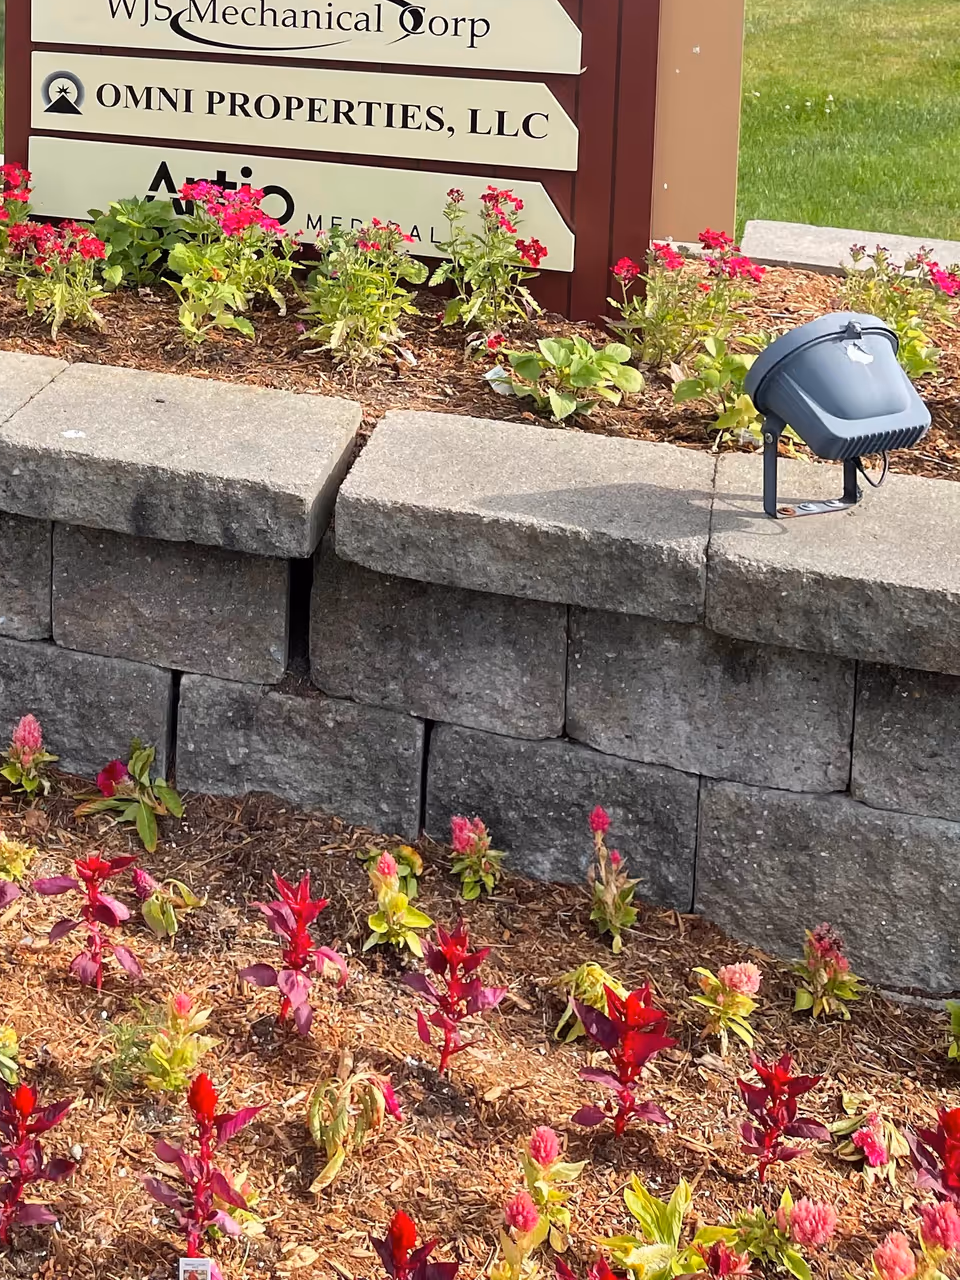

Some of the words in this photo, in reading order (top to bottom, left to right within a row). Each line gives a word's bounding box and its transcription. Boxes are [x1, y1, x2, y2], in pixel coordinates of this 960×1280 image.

[398, 5, 491, 48] Corp
[97, 84, 193, 113] OMNI
[205, 91, 454, 138] PROPERTIES,
[468, 109, 549, 139] LLC
